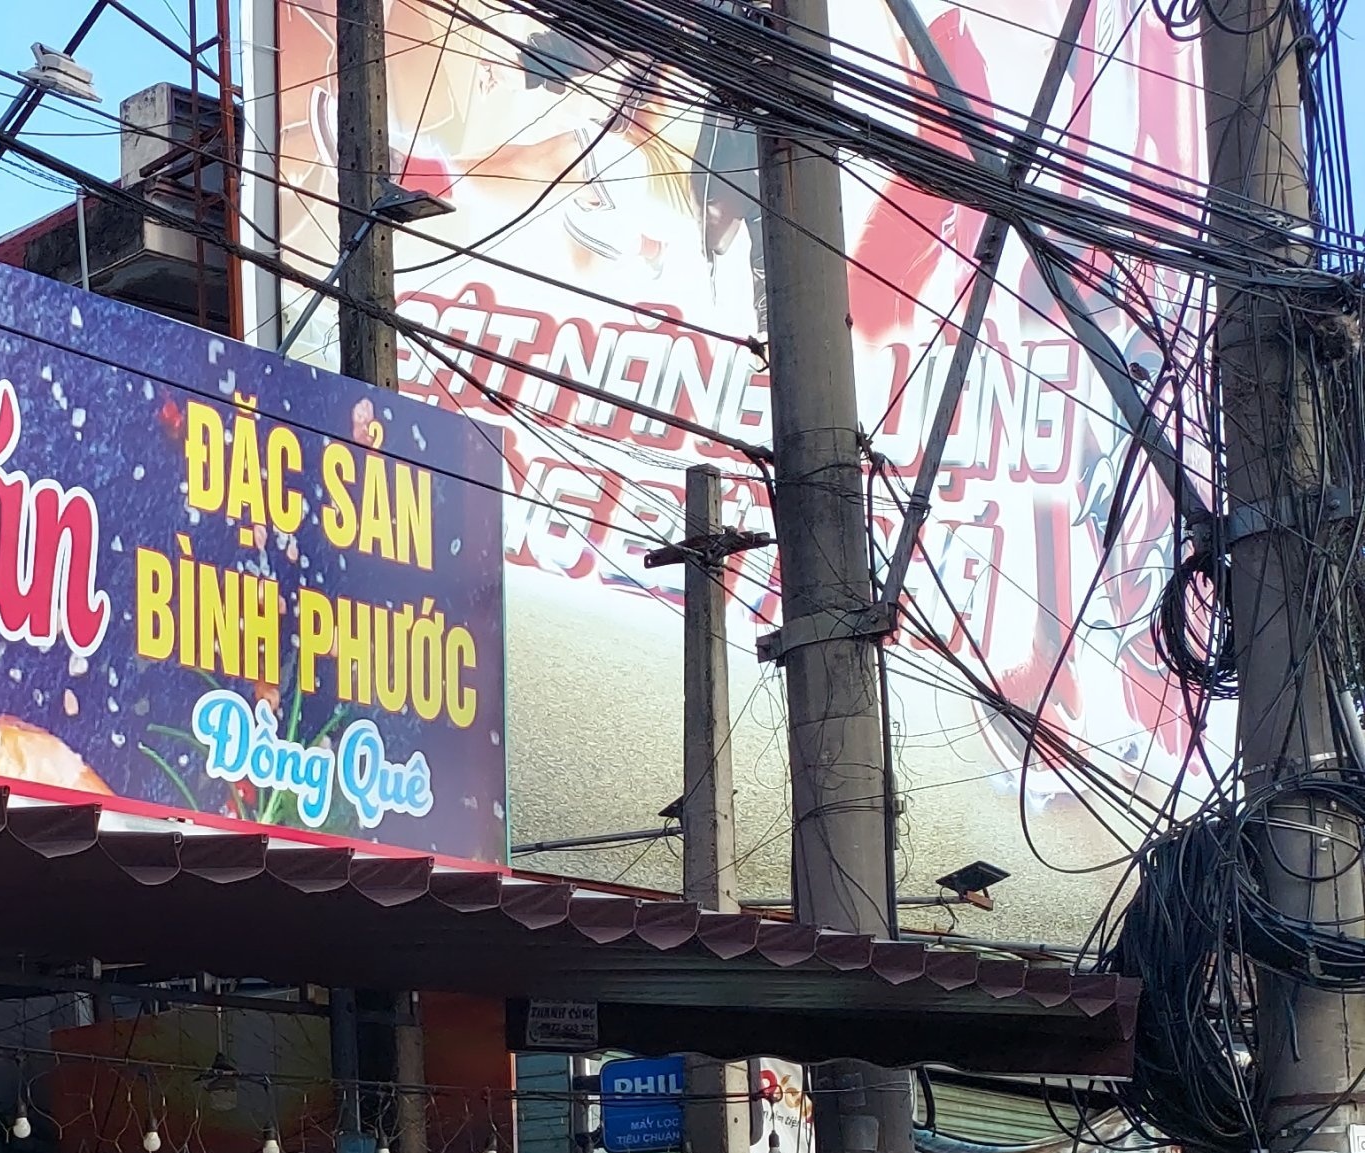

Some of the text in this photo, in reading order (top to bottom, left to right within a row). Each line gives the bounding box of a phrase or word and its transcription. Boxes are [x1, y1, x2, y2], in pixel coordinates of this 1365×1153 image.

[184, 391, 304, 547] ĐẶC
[321, 420, 434, 571] SẢN
[136, 533, 477, 728] BÌNH PHƯỚC
[195, 693, 432, 824] Đồng Quê
